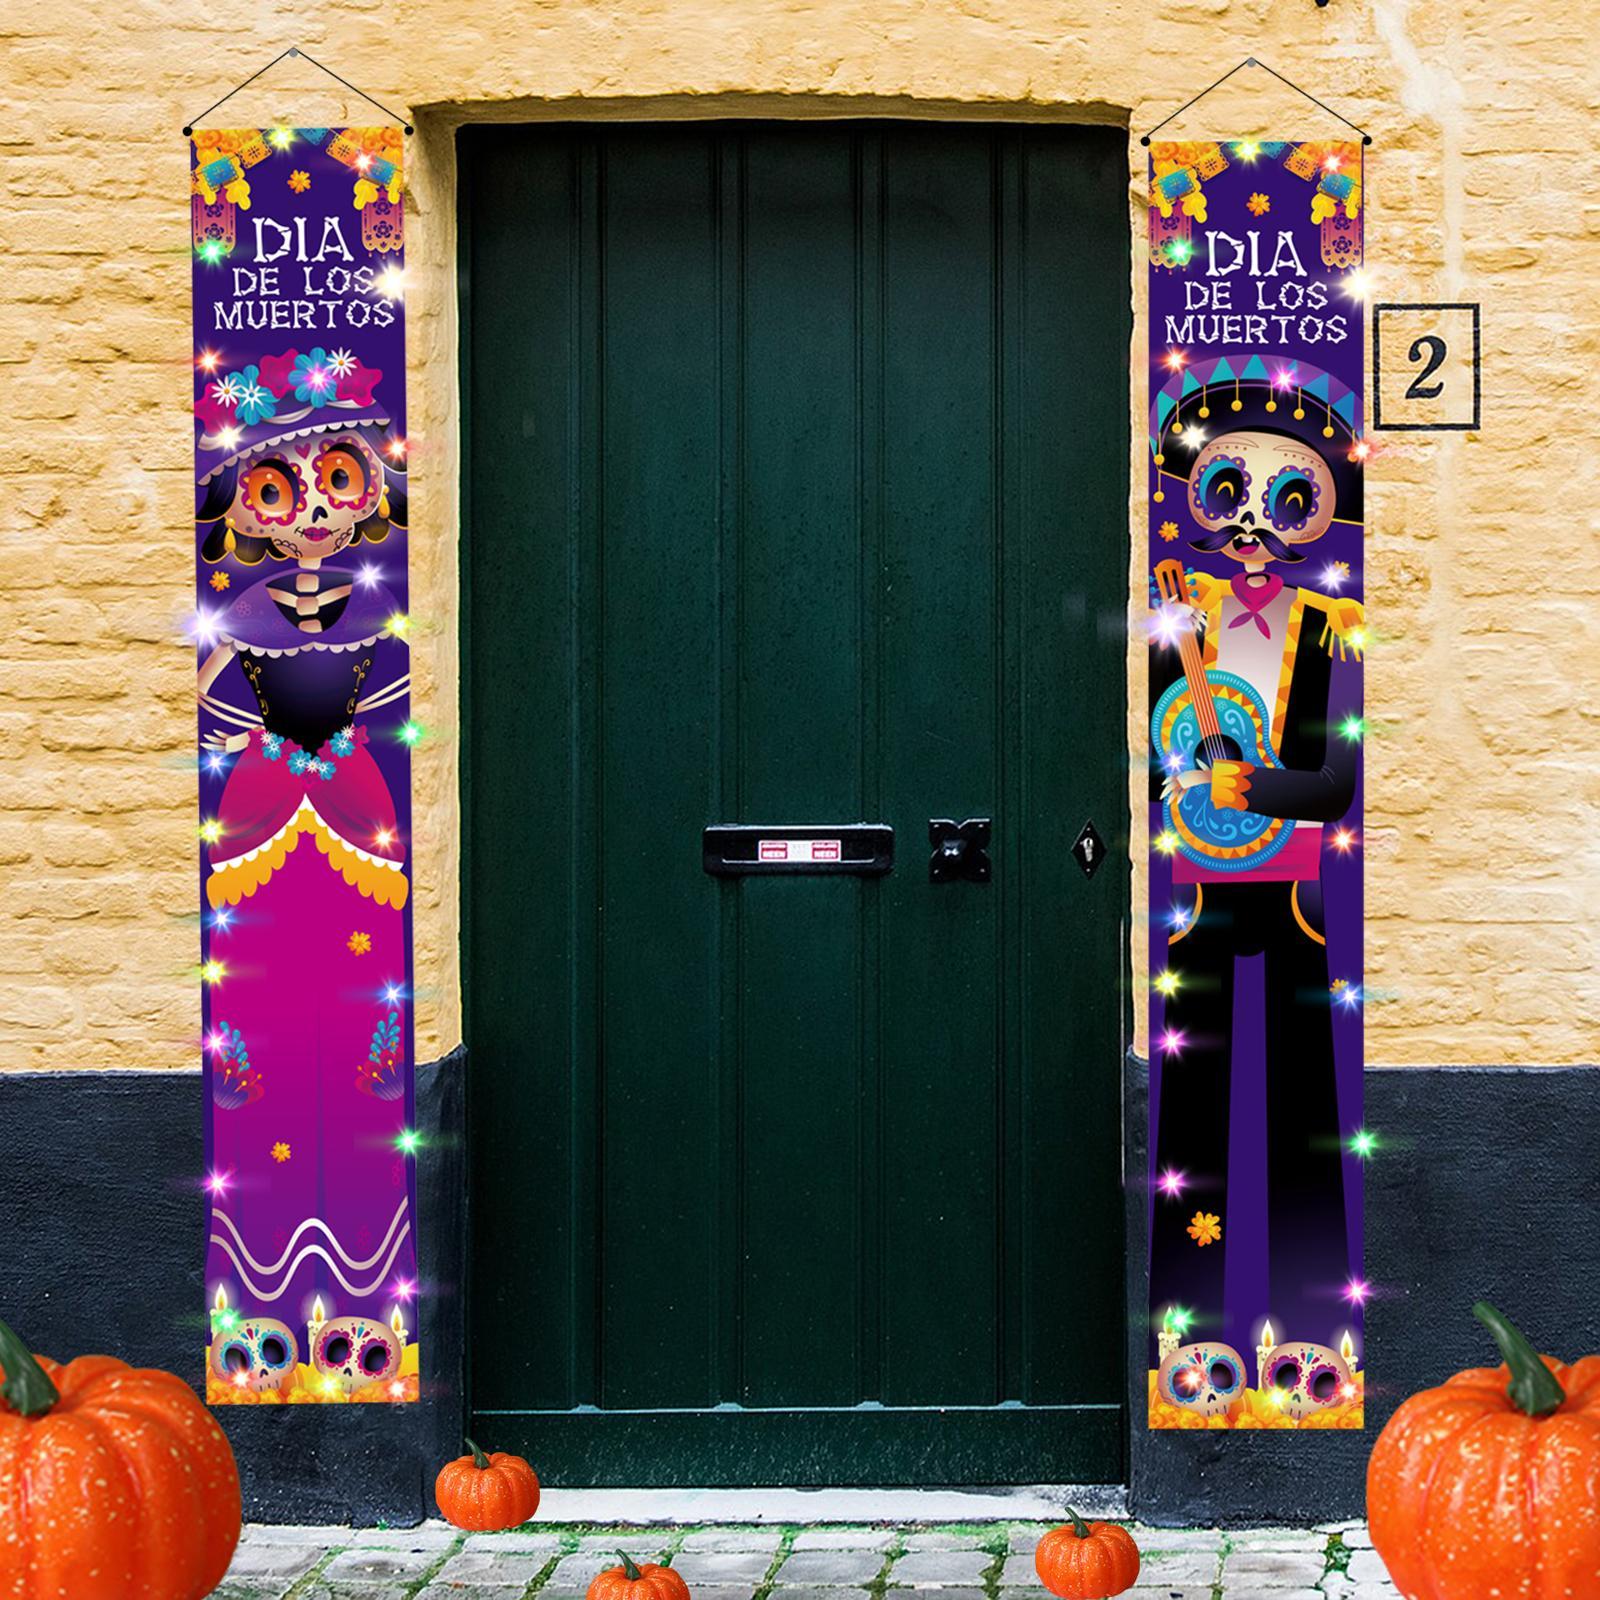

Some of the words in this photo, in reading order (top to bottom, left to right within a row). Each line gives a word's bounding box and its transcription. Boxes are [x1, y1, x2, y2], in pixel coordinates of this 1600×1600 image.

[252, 216, 354, 263] DIA
[1204, 230, 1308, 277] DIA
[232, 267, 280, 297] DE
[303, 266, 374, 296] LOS
[1184, 281, 1232, 311] DE
[1255, 280, 1328, 311] LOS
[213, 299, 395, 330] MUERTOS
[1164, 314, 1348, 344] MUERTOS
[1404, 334, 1447, 400] 2
